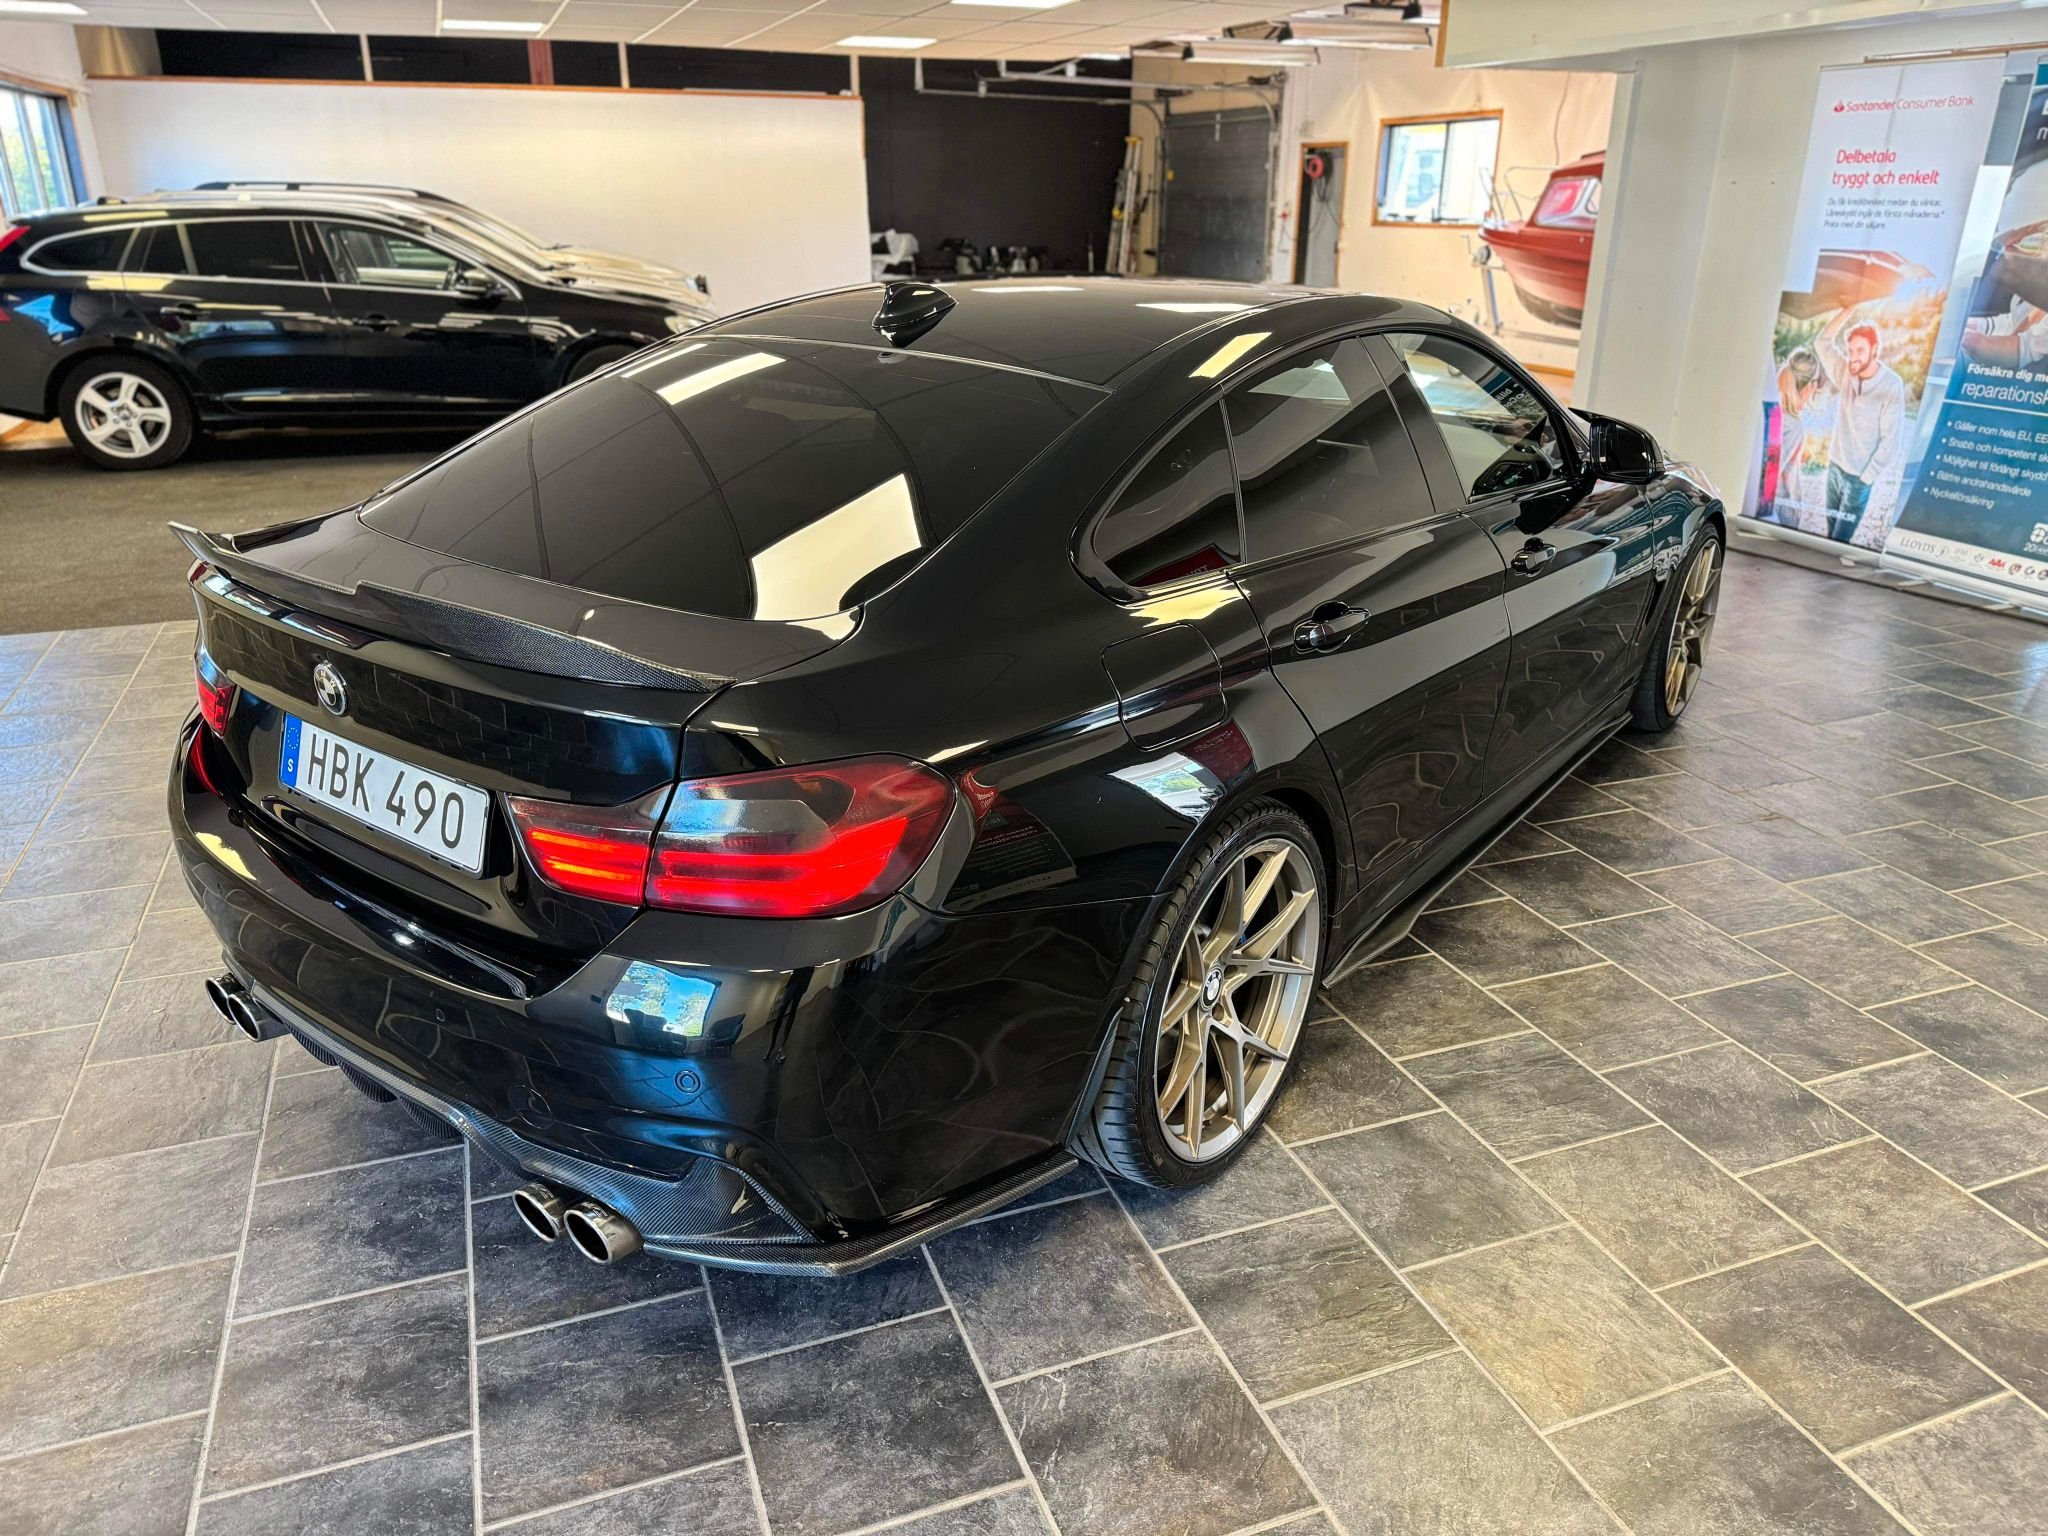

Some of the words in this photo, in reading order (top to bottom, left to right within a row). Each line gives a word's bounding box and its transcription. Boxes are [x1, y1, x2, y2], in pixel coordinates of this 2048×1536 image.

[1846, 100, 1896, 113] Santander
[1896, 98, 1947, 110] Consumer
[1947, 95, 1975, 107] Bank
[1836, 148, 1897, 164] Delbetala
[1832, 171, 1870, 189] tryggt
[1873, 169, 1896, 185] och
[1898, 169, 1940, 185] enkelt
[1967, 363, 2014, 379] Försäkra
[2015, 369, 2033, 383] dig
[1954, 420, 1978, 433] Gäller
[1978, 425, 1998, 436] inom
[1999, 428, 2017, 439] hela
[2017, 430, 2032, 442] EU,
[1948, 437, 1975, 450] Snabb
[1975, 443, 1992, 453] och
[1993, 445, 2037, 461] kompetent
[1942, 454, 1979, 469] Möjlighet
[1979, 461, 1989, 471] till
[1989, 462, 2021, 479] förlängt
[1936, 470, 1961, 483] Bättre
[1961, 476, 2032, 497] andrahandsvärde
[1930, 487, 1995, 510] Nyckelförsäkring
[1900, 537, 1937, 554] LLOYDS
[287, 758, 295, 773] S
[307, 733, 375, 813] HBK
[385, 770, 464, 849] 490
